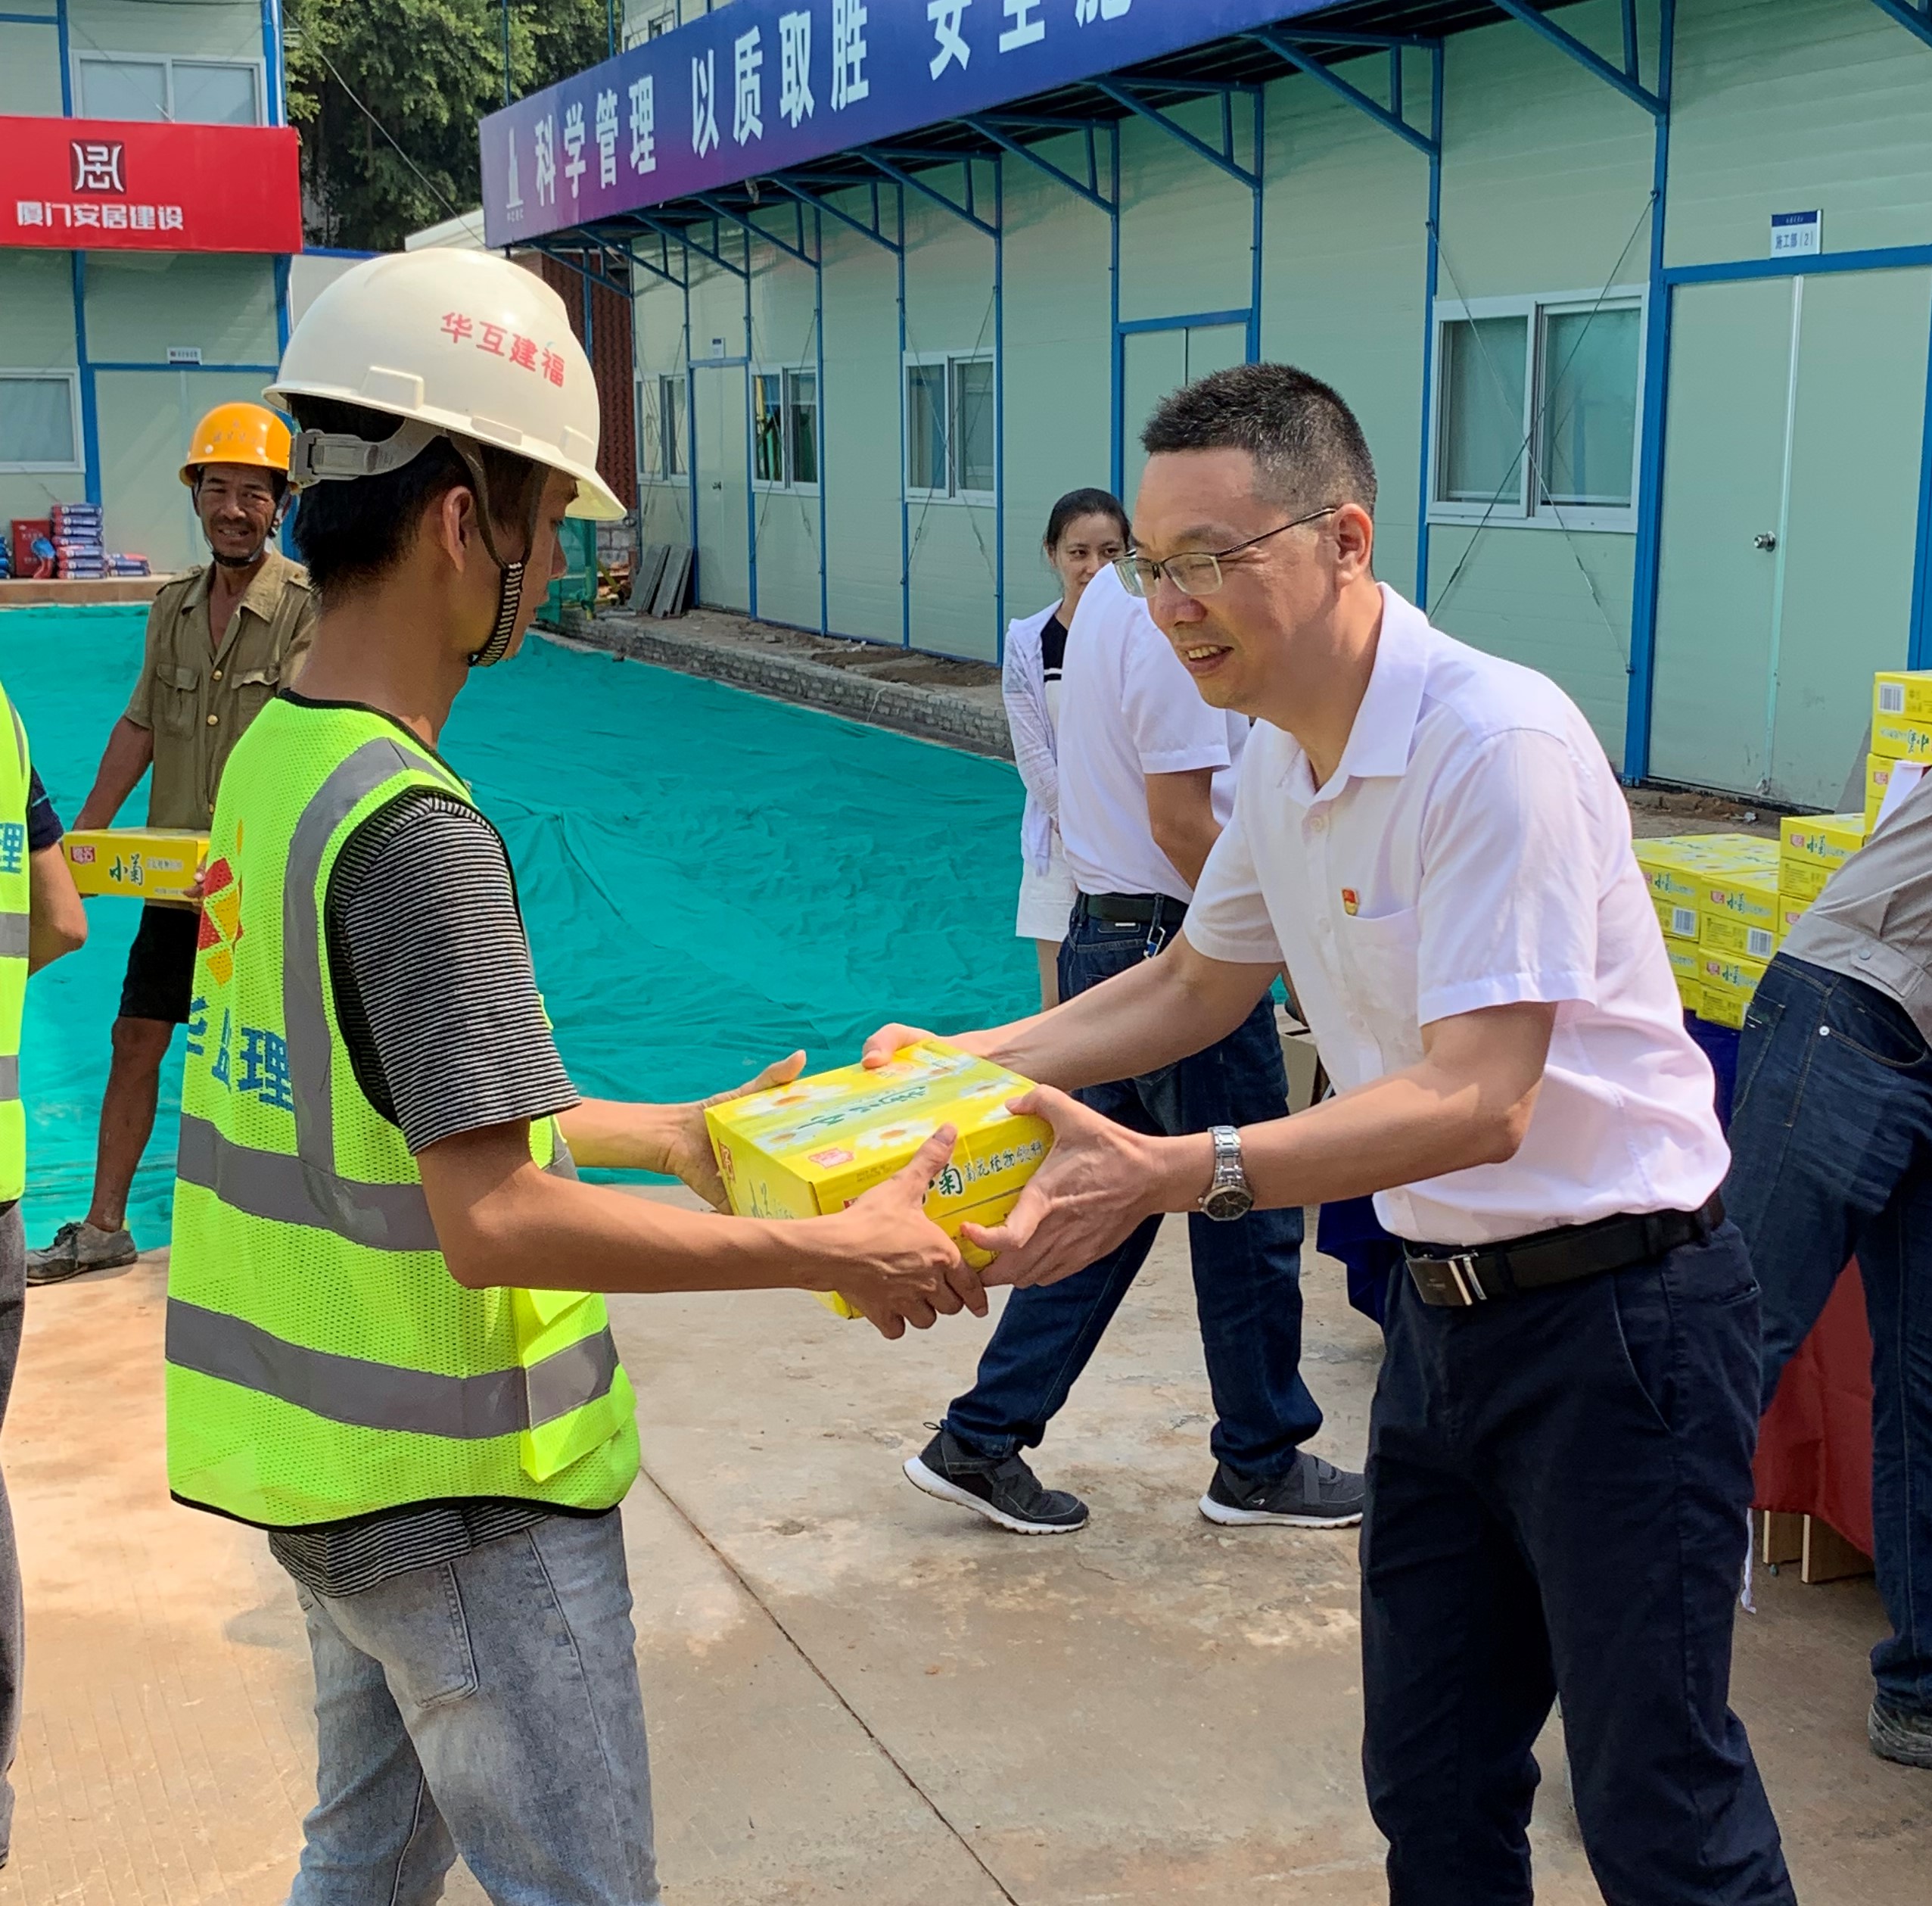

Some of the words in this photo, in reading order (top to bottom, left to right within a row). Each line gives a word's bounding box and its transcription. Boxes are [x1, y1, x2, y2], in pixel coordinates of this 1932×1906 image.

[535, 74, 657, 207] 科学管理
[692, 0, 870, 160] 以质取胜
[16, 201, 185, 231] 厦门安居建设
[440, 312, 565, 388] 华互建福
[109, 852, 144, 886] 小菊
